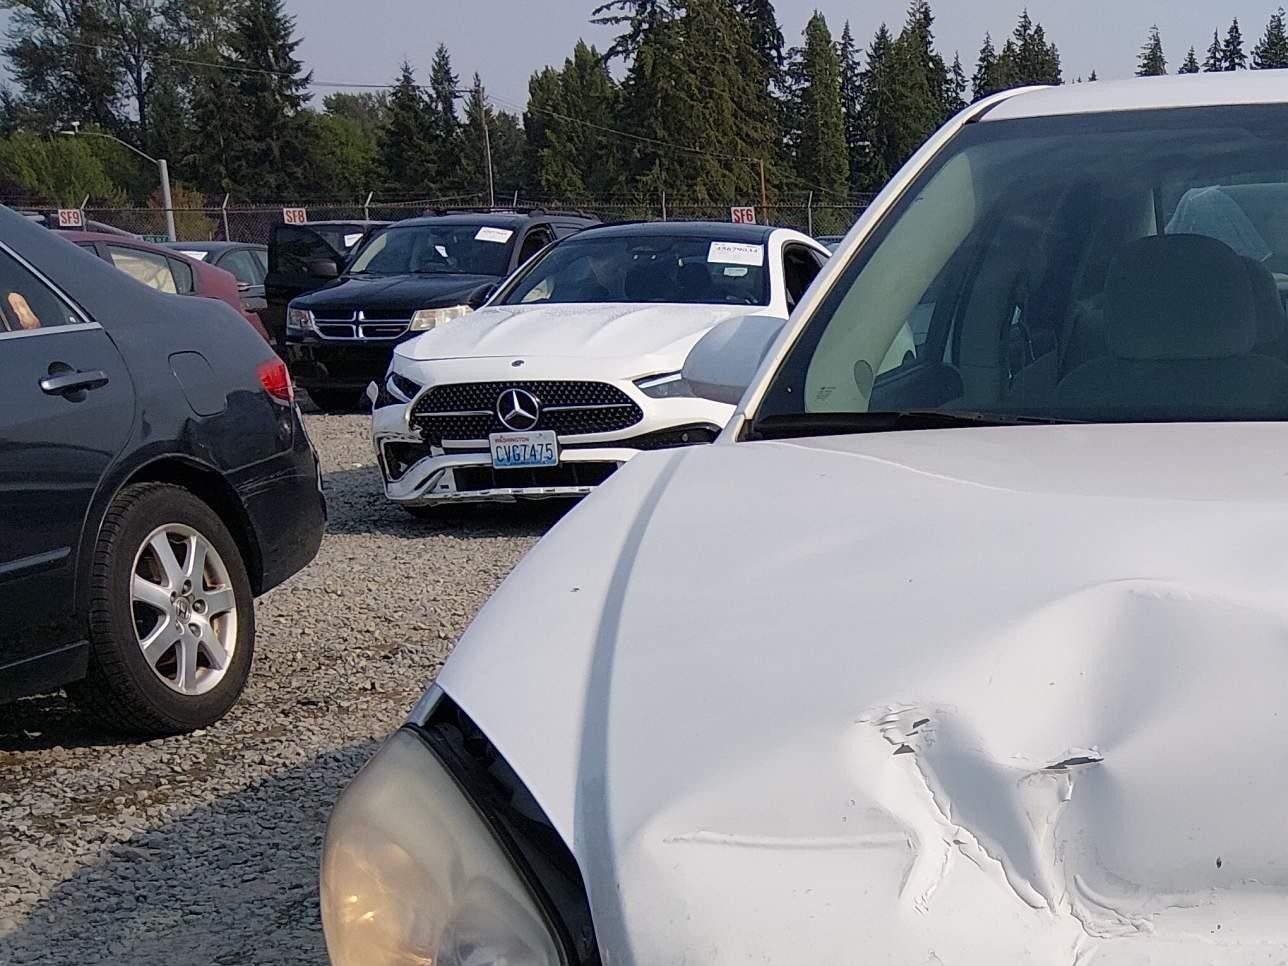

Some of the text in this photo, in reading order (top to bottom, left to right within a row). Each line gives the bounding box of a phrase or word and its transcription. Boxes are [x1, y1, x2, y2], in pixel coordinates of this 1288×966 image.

[60, 211, 80, 224] SF9
[286, 210, 305, 223] SF8
[733, 208, 753, 223] SF6
